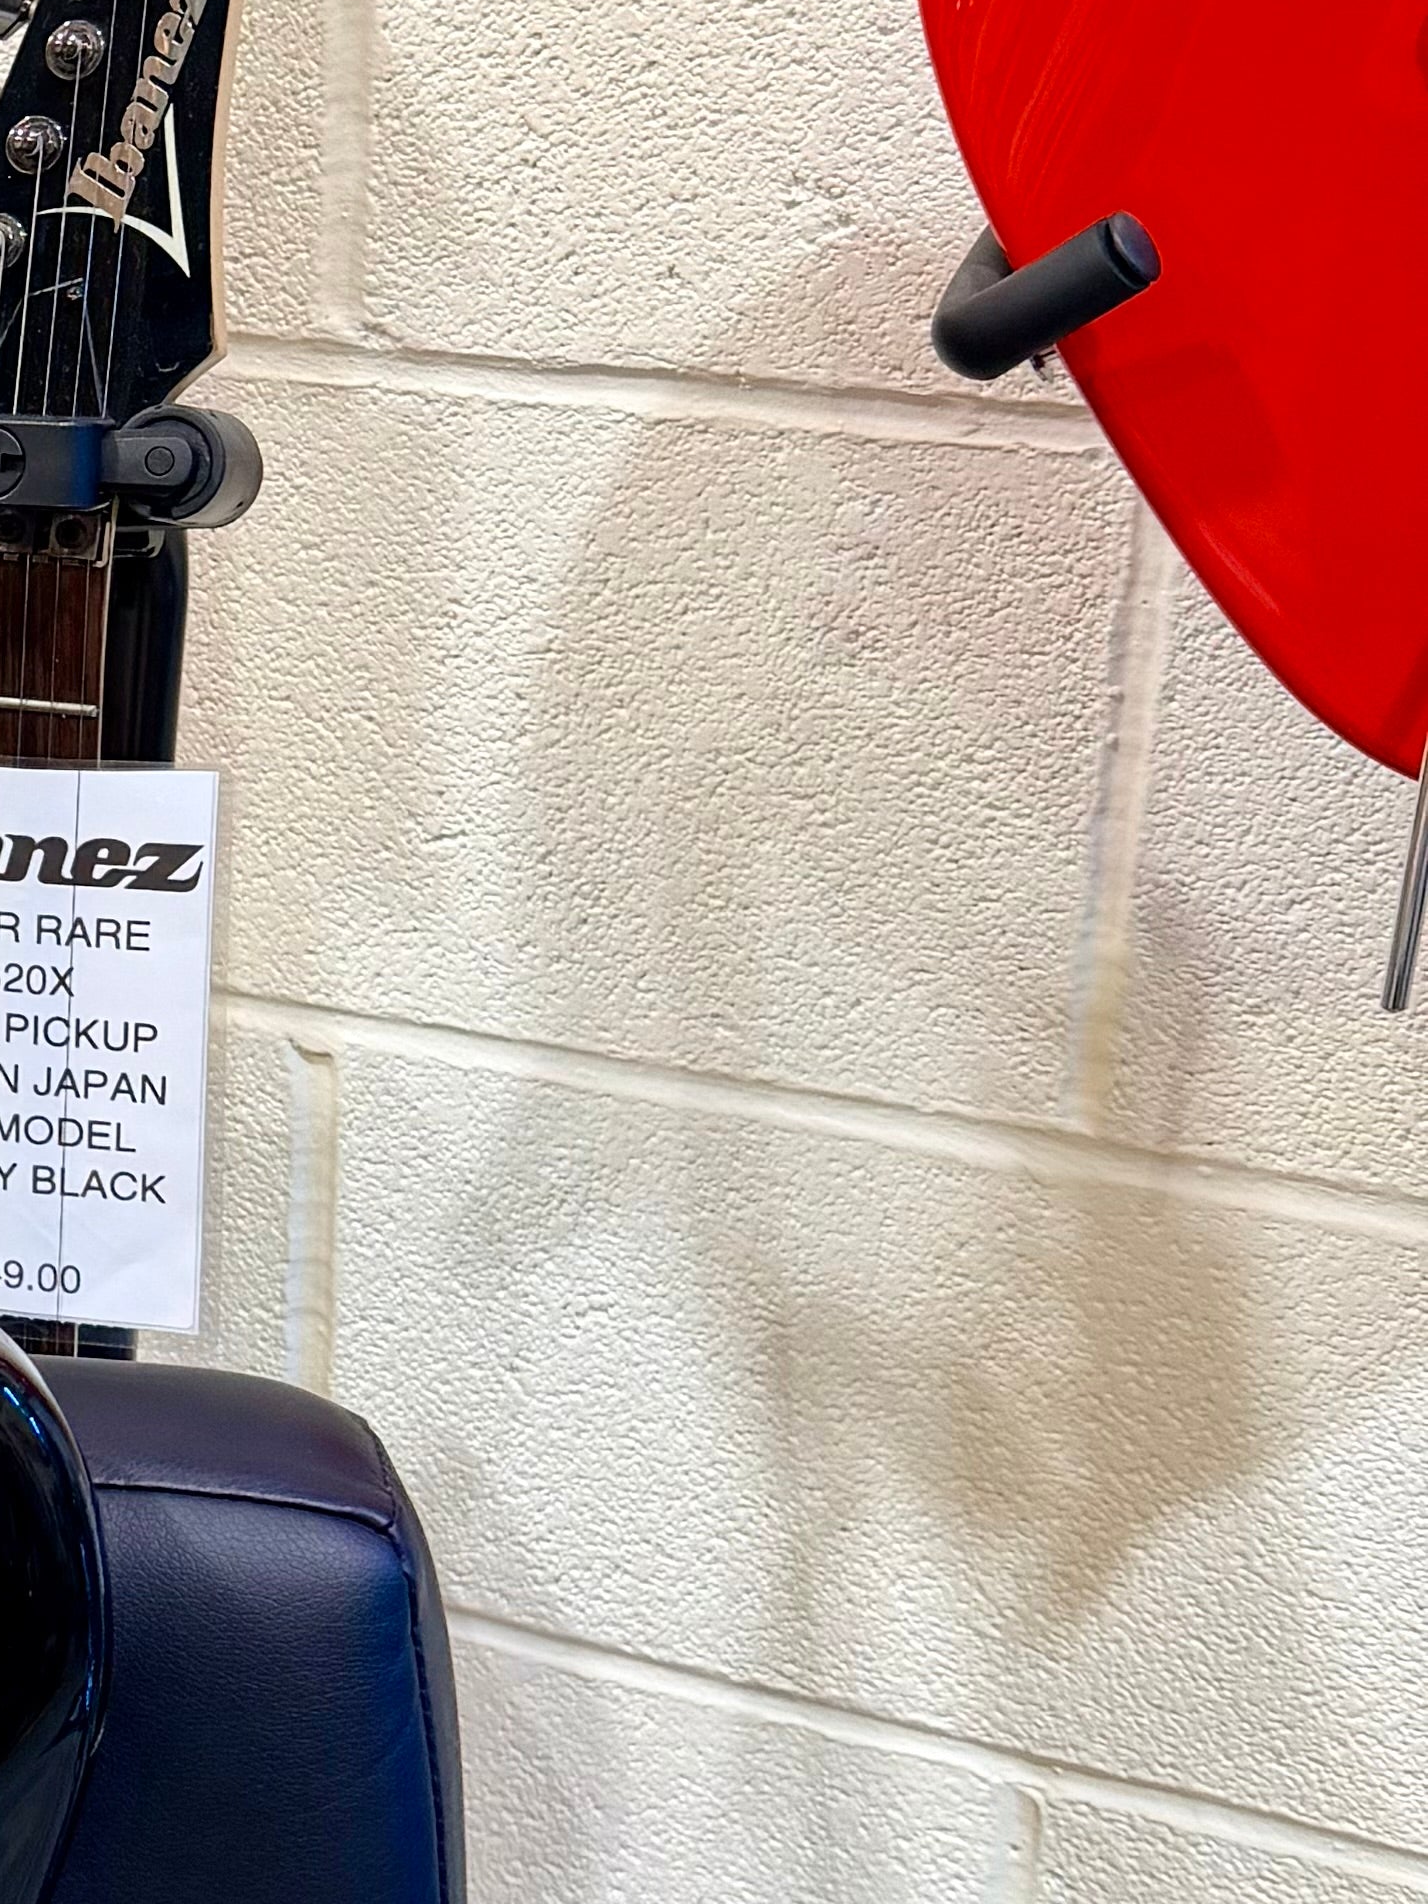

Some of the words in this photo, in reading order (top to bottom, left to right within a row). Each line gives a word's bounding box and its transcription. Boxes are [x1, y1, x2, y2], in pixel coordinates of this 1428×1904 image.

[36, 915, 151, 952] RARE
[5, 1013, 159, 1053] PICKUP
[33, 1067, 167, 1106] JAPAN
[32, 1165, 167, 1205] BLACK
